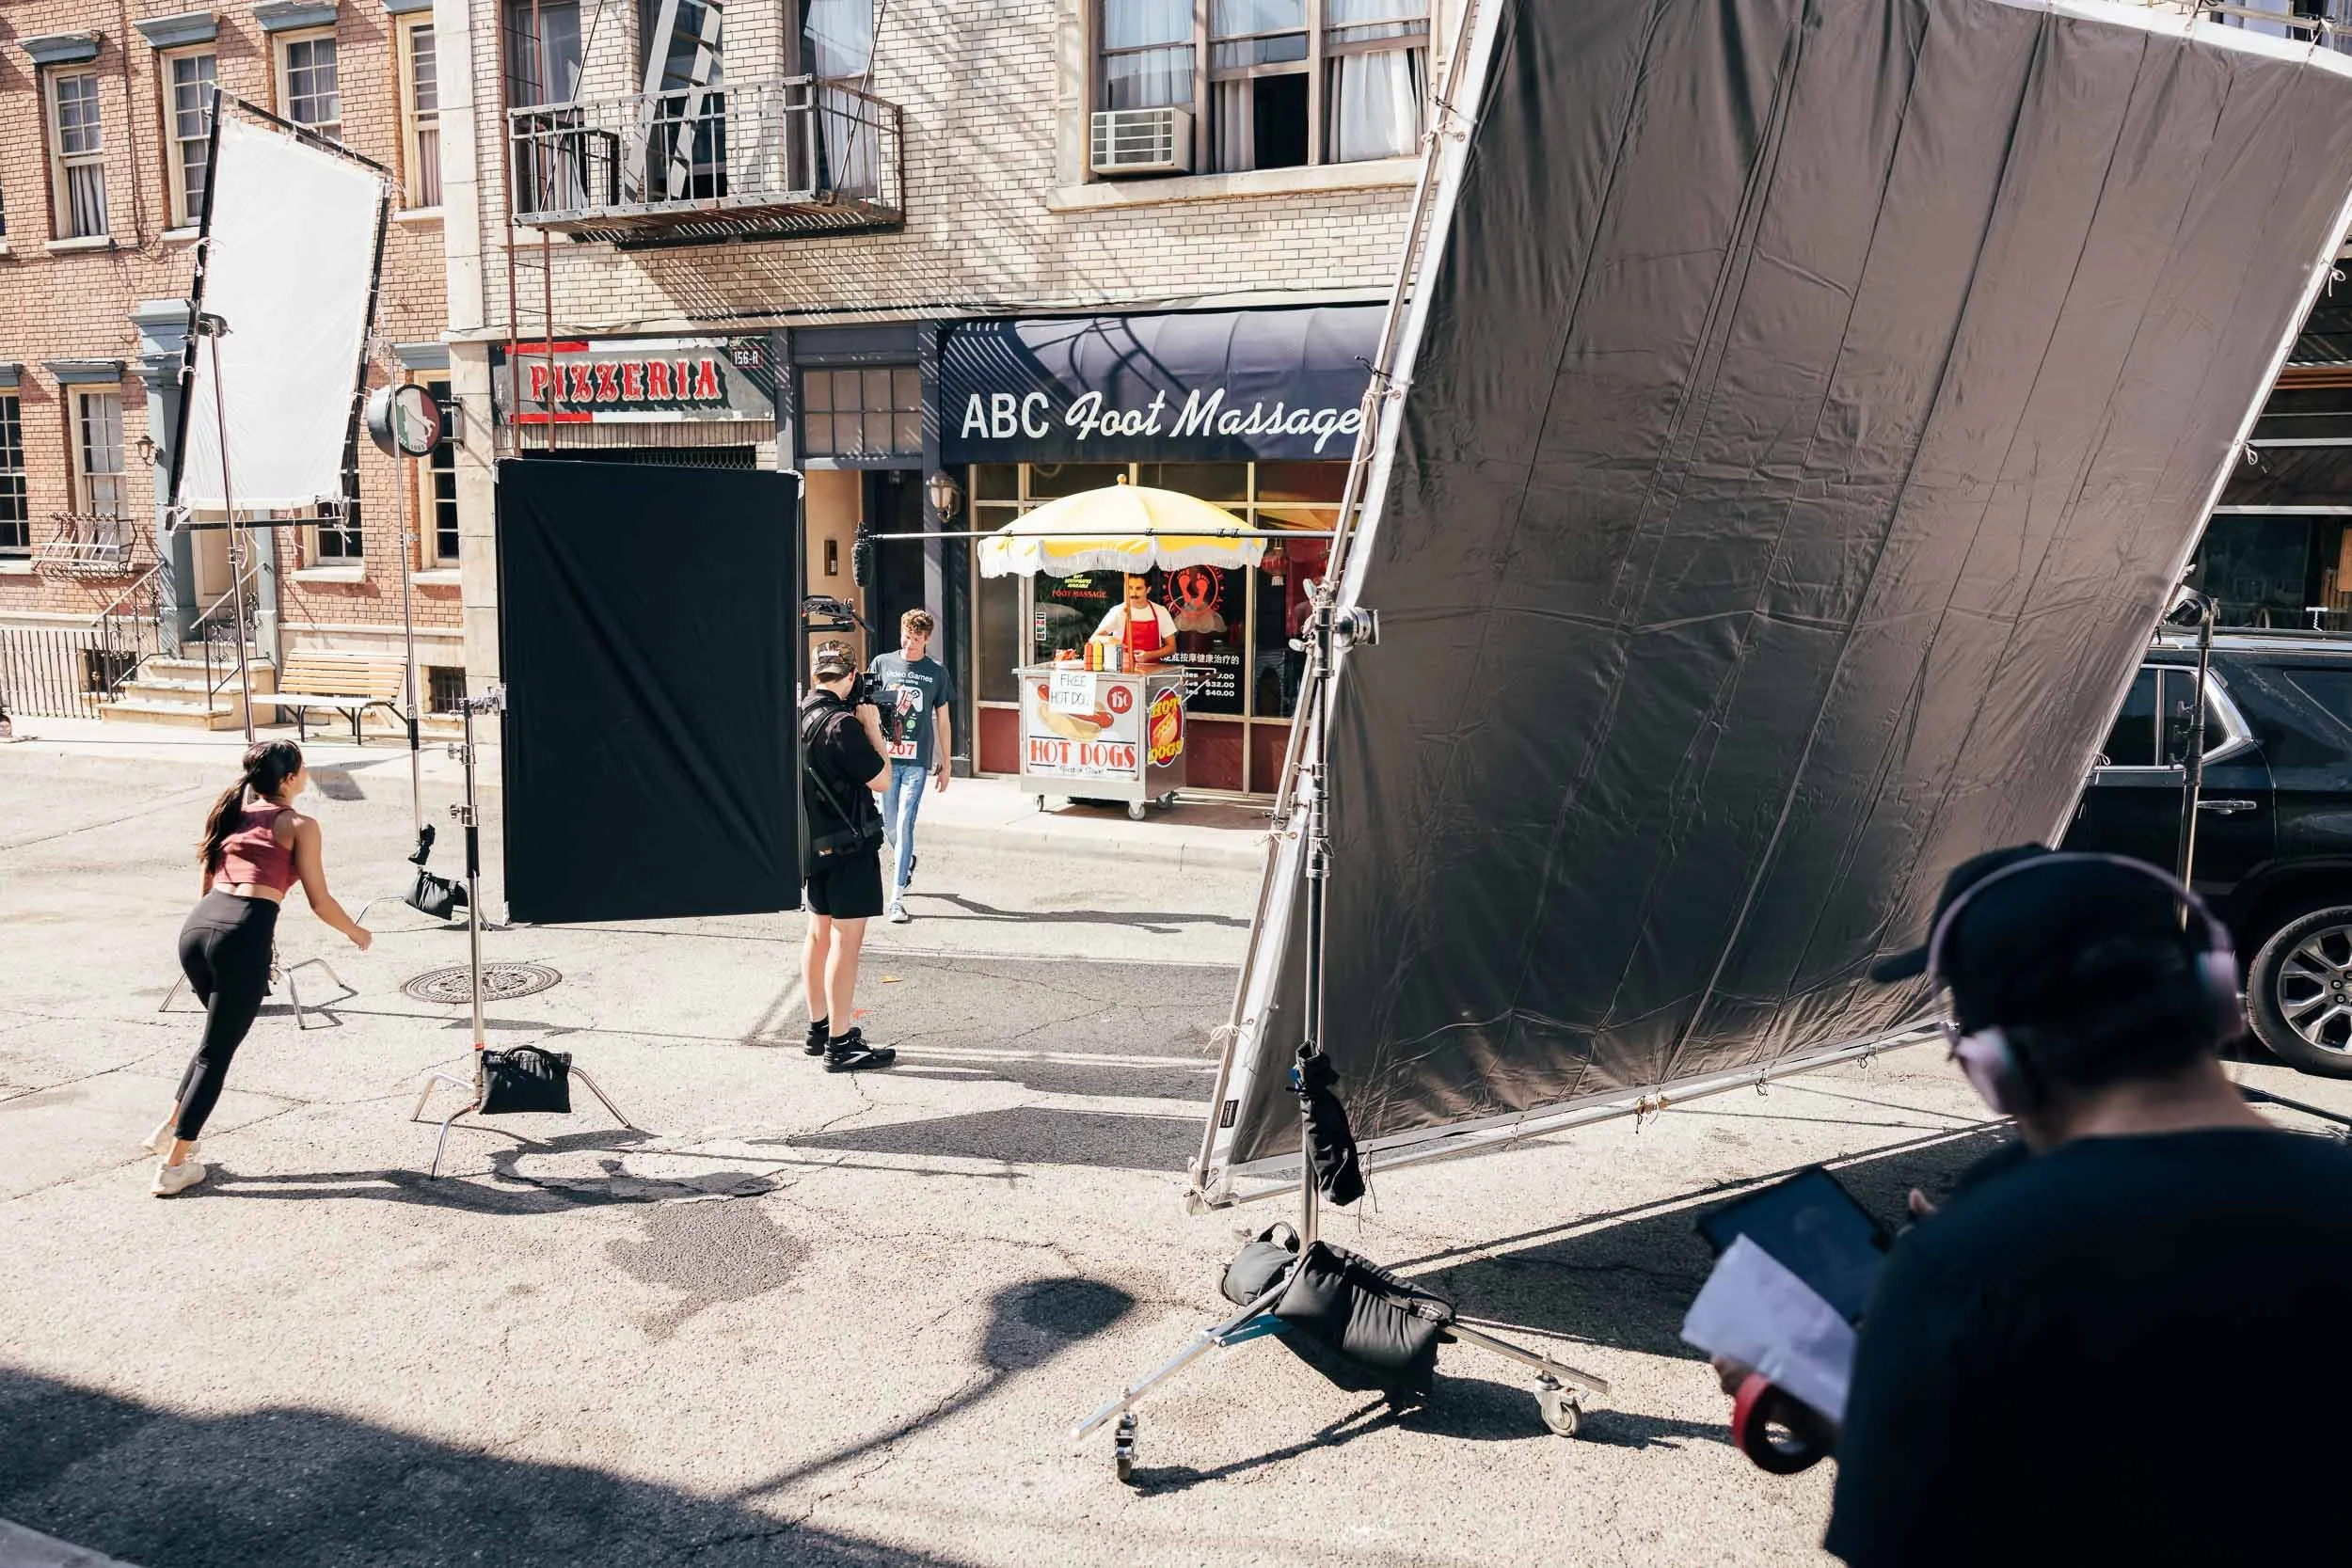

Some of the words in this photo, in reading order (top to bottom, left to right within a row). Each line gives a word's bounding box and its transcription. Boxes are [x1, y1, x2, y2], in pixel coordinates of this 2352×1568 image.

[734, 351, 759, 365] 156-R
[529, 358, 723, 403] PIZZERIA
[961, 391, 1050, 439] ABC
[1064, 389, 1166, 441] Foot
[1168, 388, 1363, 454] Massage
[1051, 590, 1071, 598] FOOT
[1073, 590, 1107, 599] MASSAGE
[907, 671, 933, 683] Games
[1060, 673, 1087, 687] FREE
[1050, 691, 1070, 705] HOT
[1205, 689, 1235, 697] $40.00
[1151, 695, 1182, 718] HOT
[1030, 739, 1072, 765] HOT
[1079, 742, 1136, 768] DOGS
[1148, 738, 1184, 764] DOGS
